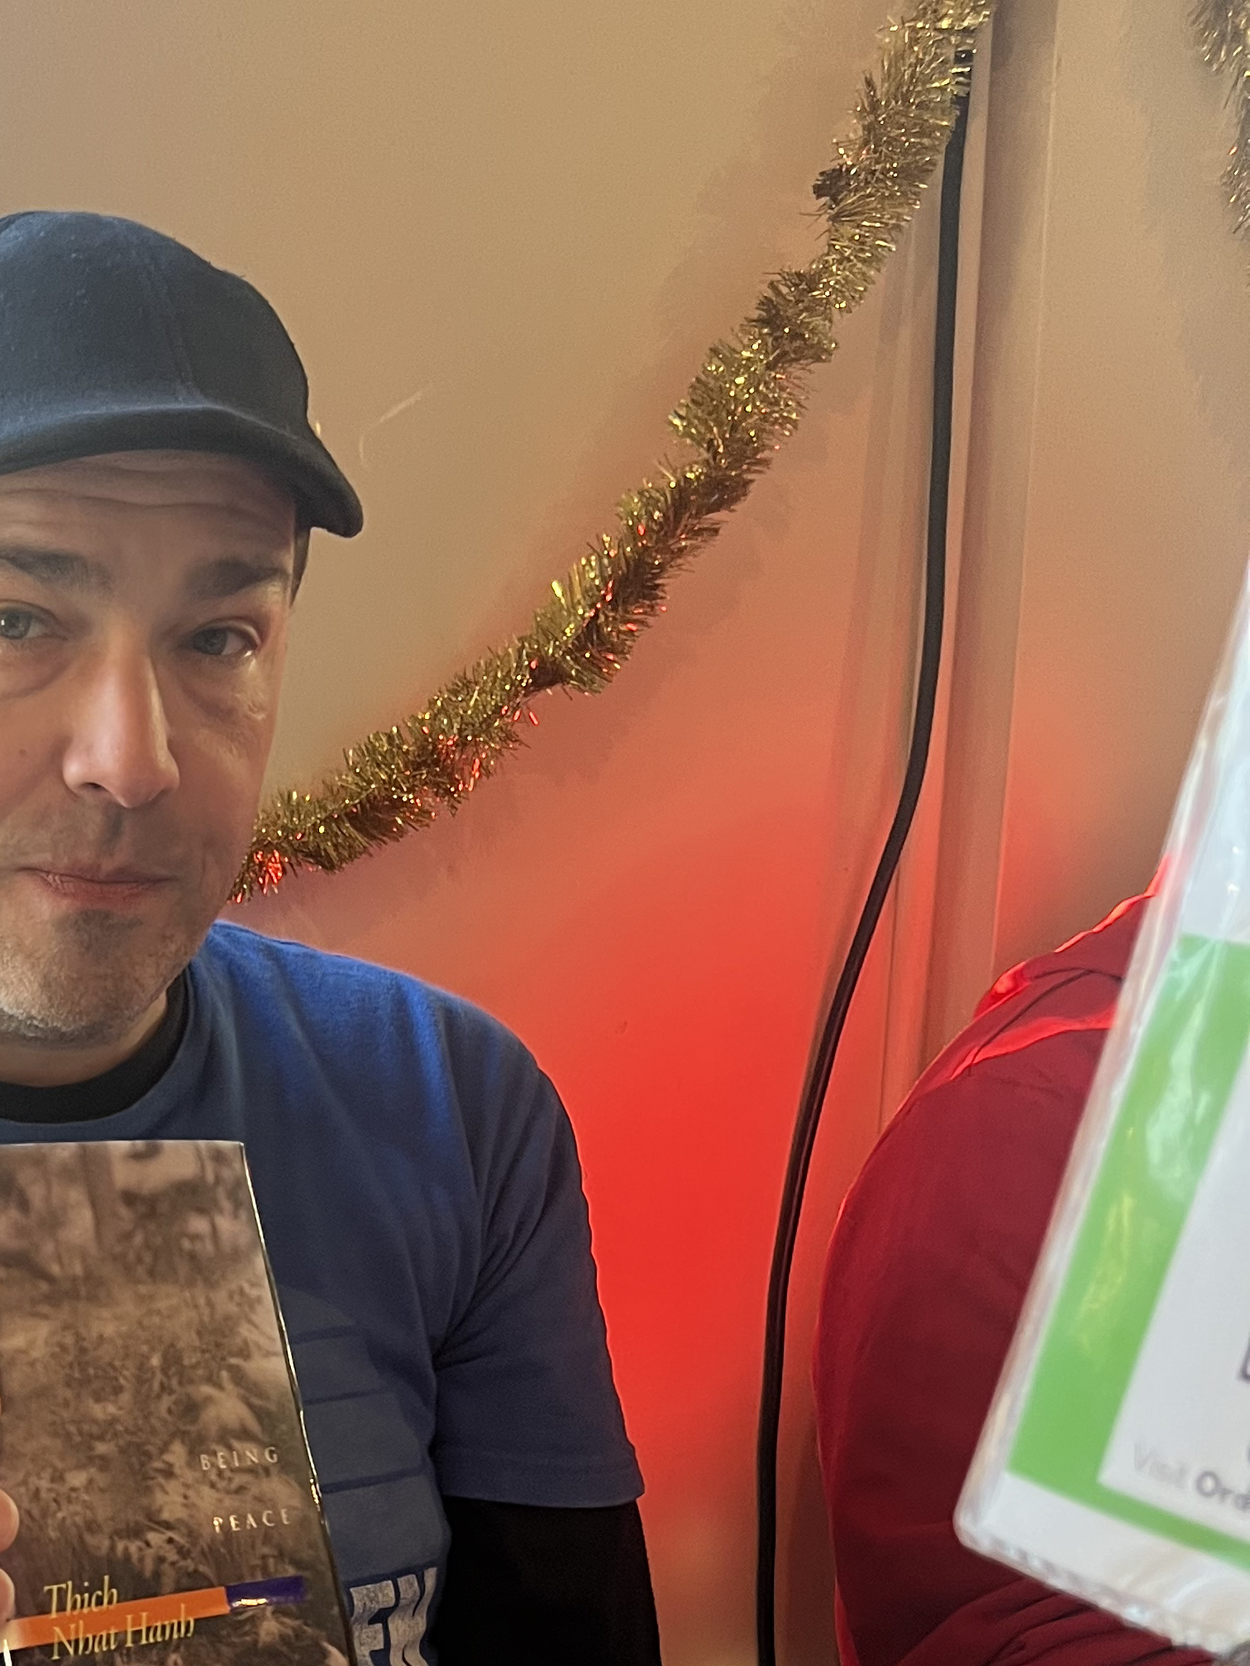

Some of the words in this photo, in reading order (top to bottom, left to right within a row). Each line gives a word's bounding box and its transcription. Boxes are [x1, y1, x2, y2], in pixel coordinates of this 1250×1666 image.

[199, 1446, 278, 1471] BEING
[212, 1508, 291, 1534] PEACE
[43, 1574, 119, 1620] Thich
[51, 1618, 119, 1661] Nhat
[124, 1602, 195, 1649] Hanh
